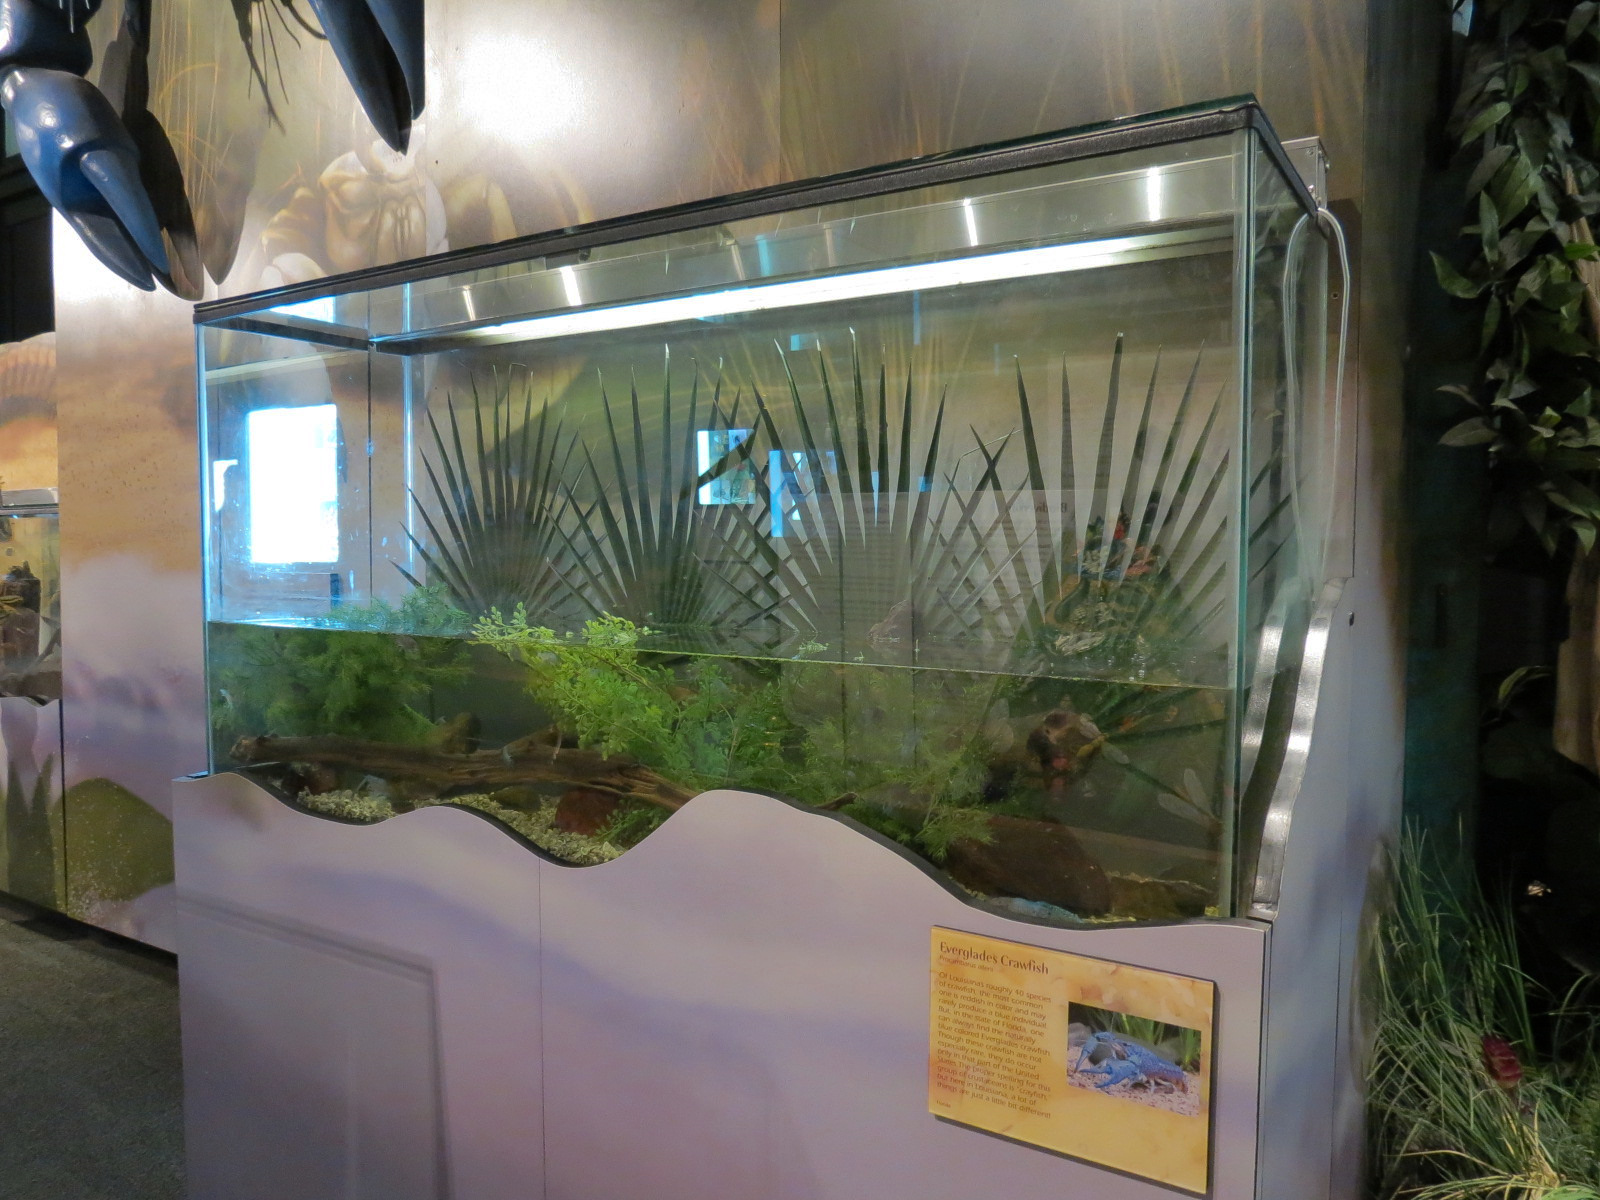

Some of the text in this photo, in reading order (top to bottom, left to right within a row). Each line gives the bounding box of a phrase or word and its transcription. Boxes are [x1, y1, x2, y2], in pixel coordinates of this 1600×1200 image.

[1001, 955, 1049, 975] Crawfish
[980, 990, 991, 998] the
[1011, 999, 1043, 1010] common
[986, 984, 1013, 995] roughly
[1026, 993, 1051, 1002] species
[939, 998, 957, 1008] rarely
[959, 1003, 988, 1014] produce
[995, 1011, 1011, 1020] blue
[960, 995, 986, 1005] reddish
[996, 1003, 1014, 1012] color
[1031, 1012, 1047, 1021] may
[962, 1011, 974, 1019] the
[938, 1023, 952, 1031] blue
[954, 1028, 980, 1038] colored
[981, 1035, 1019, 1048] Everglades
[938, 1031, 964, 1042] Though
[966, 1039, 985, 1048] these
[986, 1044, 1015, 1055] crawfish
[952, 1019, 975, 1029] always
[977, 1024, 990, 1032] find
[992, 1028, 1004, 1036] the
[1005, 1032, 1037, 1045] naturally
[938, 1041, 970, 1053] especially
[988, 1053, 1004, 1062] they
[1017, 1062, 1037, 1071] occur
[938, 1049, 953, 1057] only
[962, 1055, 976, 1063] that
[977, 1059, 991, 1067] part
[1002, 1065, 1014, 1073] the
[1016, 1069, 1040, 1080] United
[937, 1066, 958, 1076] group
[968, 1074, 1008, 1089] crustaceans
[937, 1073, 949, 1081] but
[950, 1077, 966, 1086] here
[959, 1062, 971, 1070] The
[973, 1067, 995, 1076] proper
[998, 1074, 1024, 1086] spelling
[1038, 1084, 1051, 1092] this
[937, 1081, 958, 1093] things
[971, 1091, 984, 1099] just
[992, 1097, 1007, 1106] little
